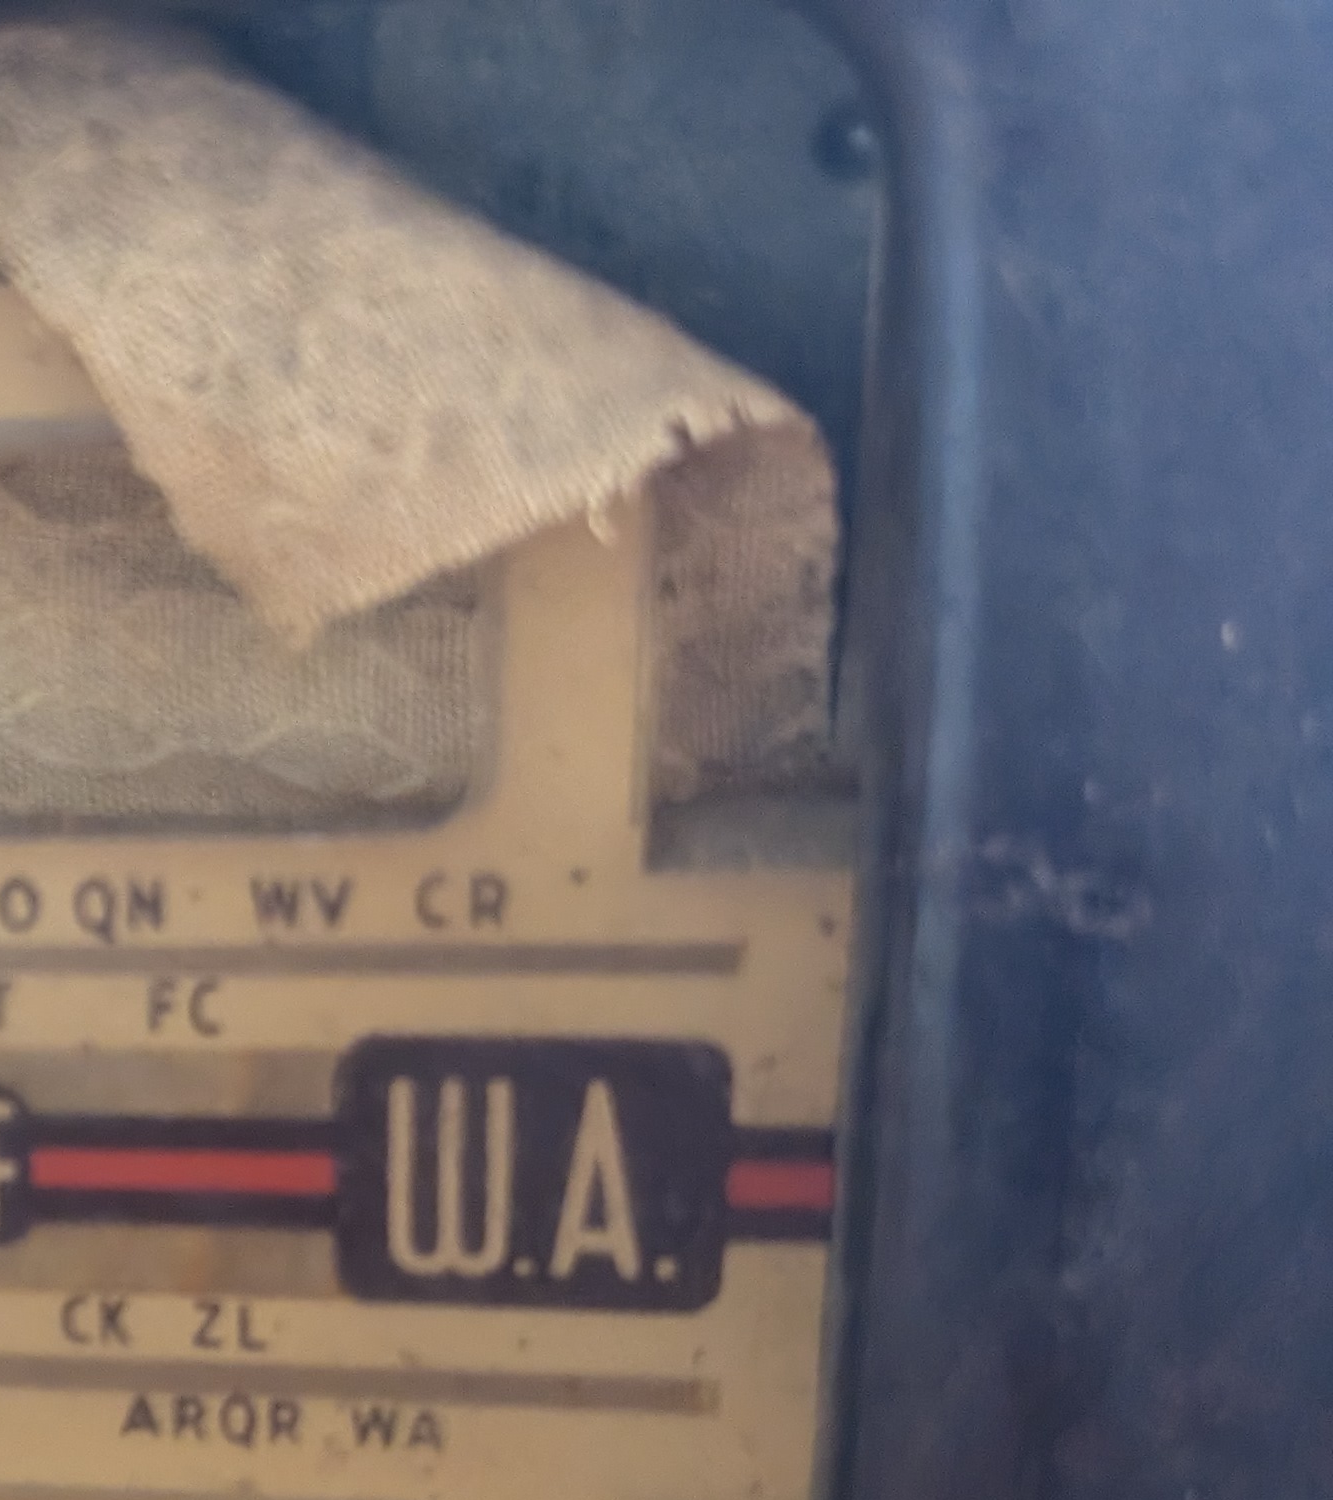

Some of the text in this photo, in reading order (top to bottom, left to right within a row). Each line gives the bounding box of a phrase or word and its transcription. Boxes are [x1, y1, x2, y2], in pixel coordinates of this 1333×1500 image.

[72, 876, 166, 944] QN
[251, 878, 352, 929] WV
[415, 872, 510, 930] CR
[146, 980, 223, 1038] FC
[60, 1294, 130, 1345] CK
[191, 1300, 267, 1352] ZL
[352, 1404, 443, 1450] WA
